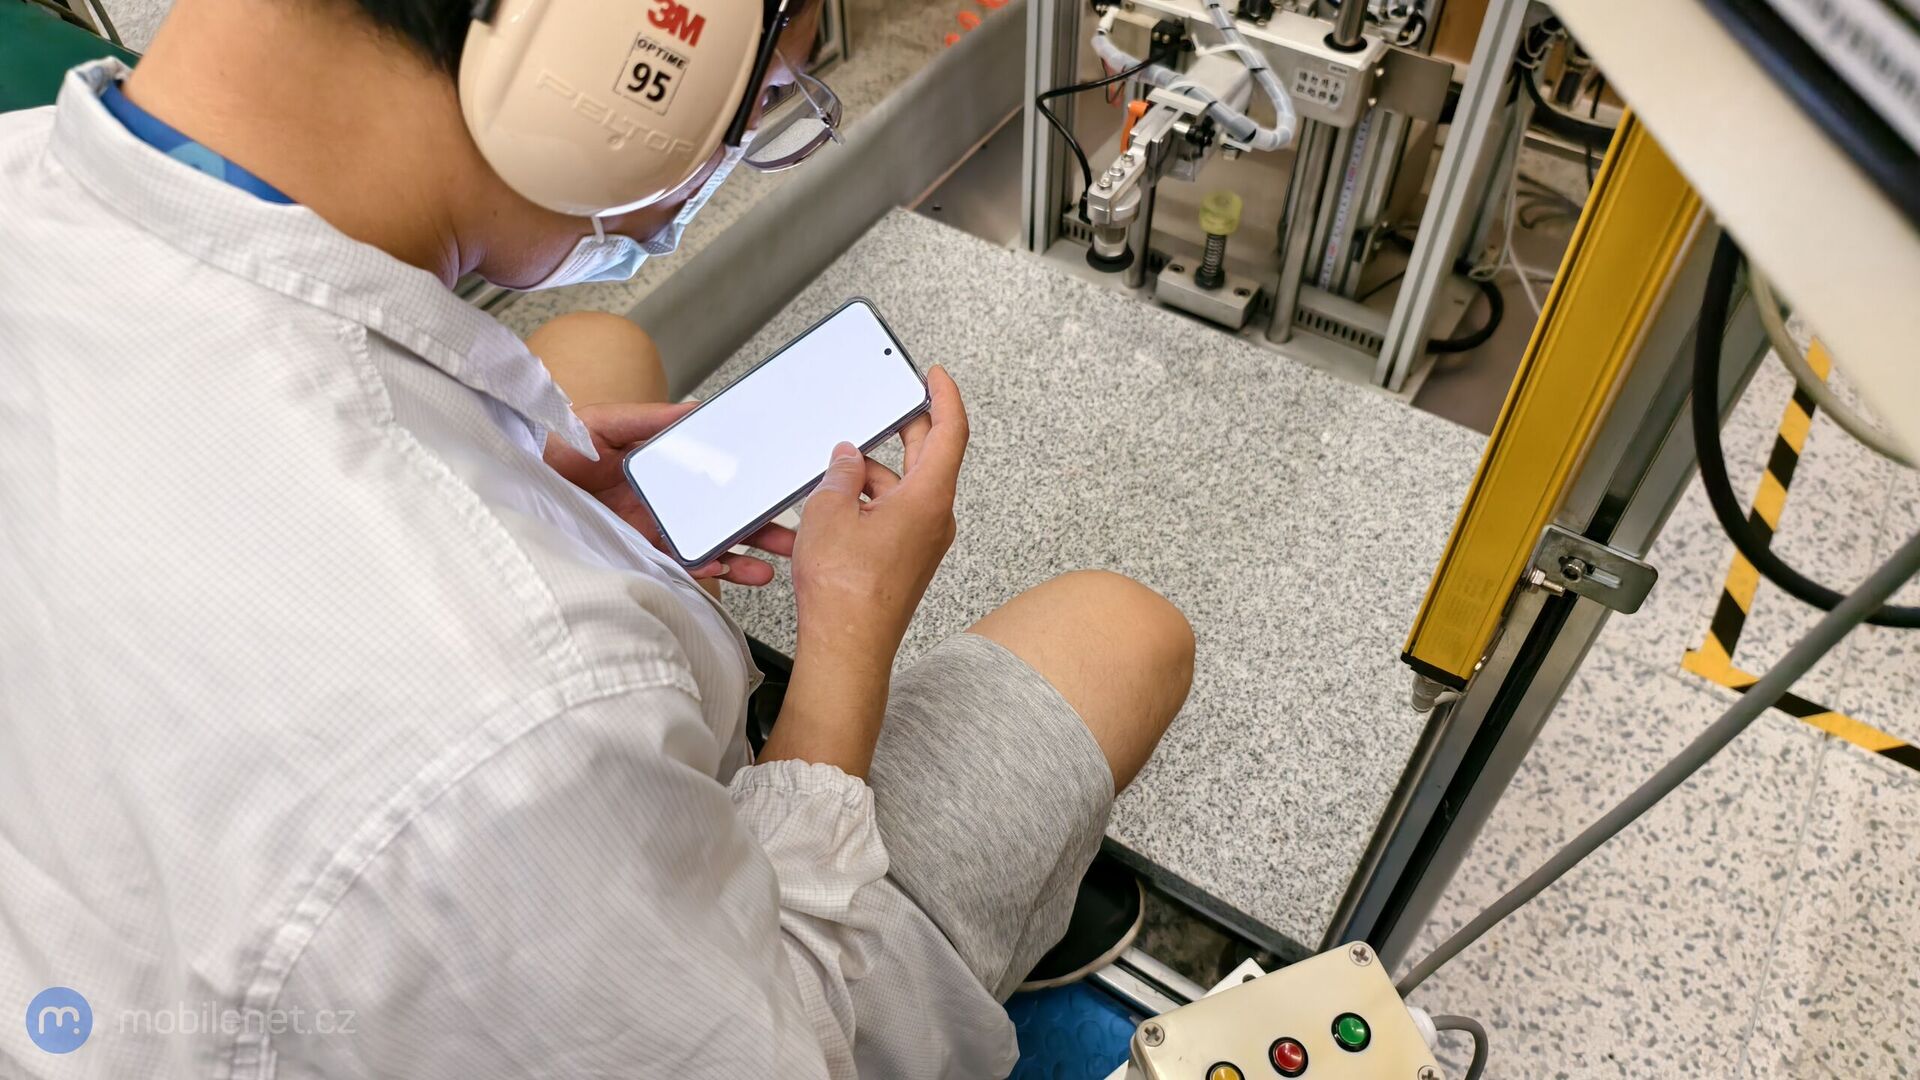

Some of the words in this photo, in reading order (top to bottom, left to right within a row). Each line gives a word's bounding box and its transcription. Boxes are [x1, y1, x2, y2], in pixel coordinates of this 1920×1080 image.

[647, 0, 706, 48] 3M
[637, 39, 687, 70] OPTIME
[626, 62, 672, 102] 95
[536, 69, 696, 157] PELTOR
